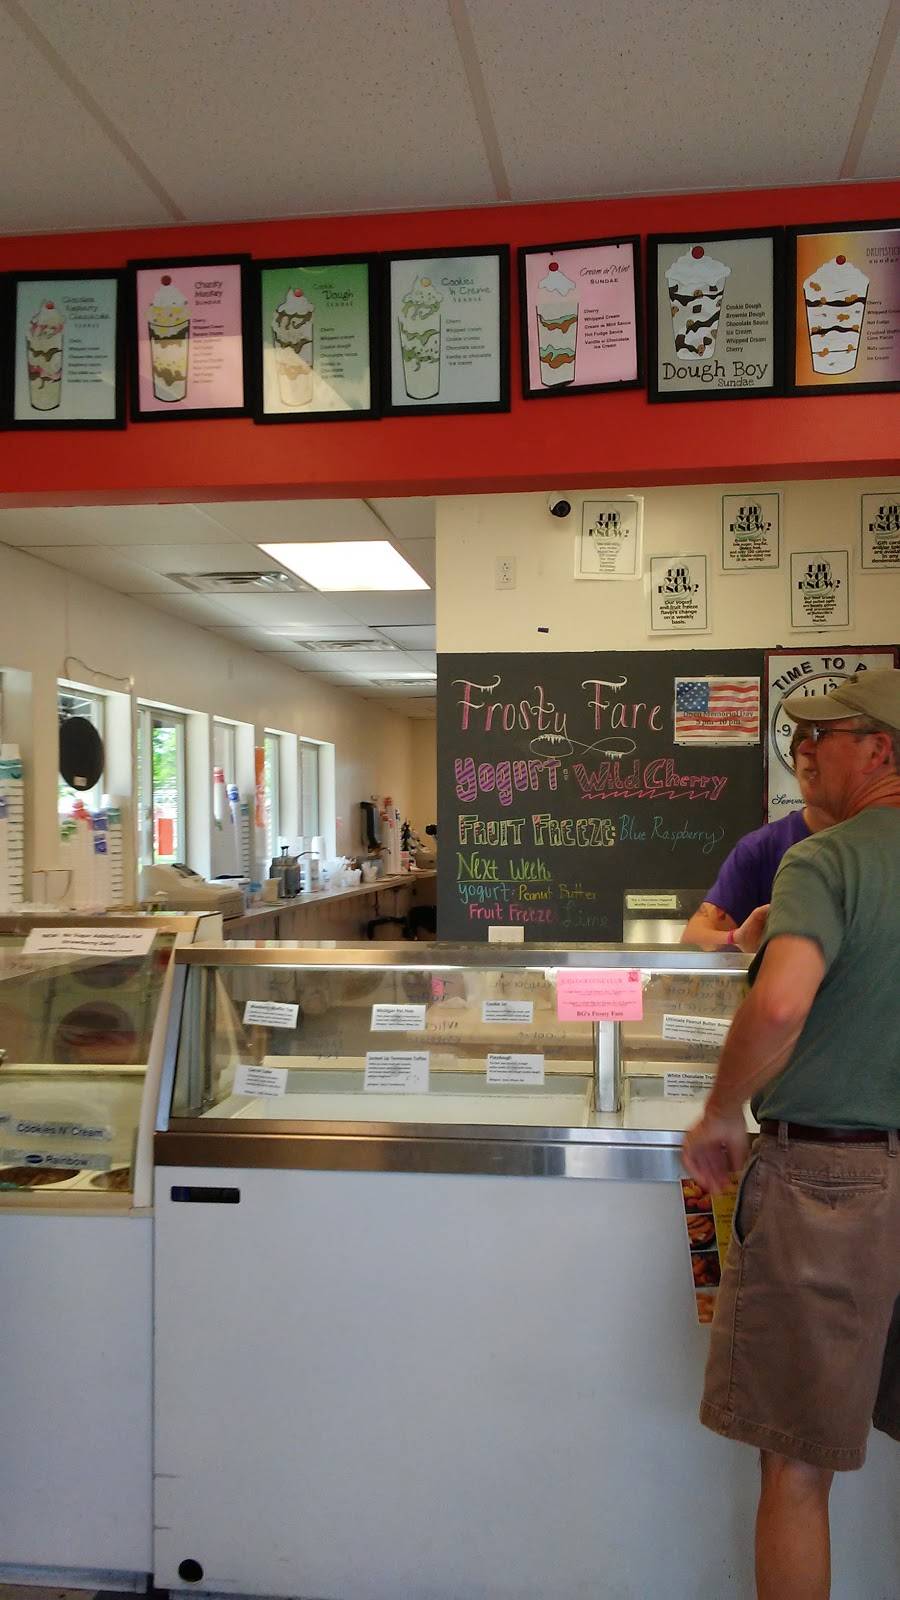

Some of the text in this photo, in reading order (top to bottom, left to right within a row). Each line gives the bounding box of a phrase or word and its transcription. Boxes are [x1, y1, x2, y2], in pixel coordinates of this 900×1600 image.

[321, 289, 354, 301] Dough
[662, 360, 769, 382] Dough Boy
[717, 377, 755, 388] Sundae
[771, 661, 813, 692] TIME
[821, 657, 845, 670] TO
[451, 675, 664, 738] Frosty Fare
[781, 724, 792, 740] 9
[572, 759, 641, 792] Wild
[642, 757, 728, 801] Cherry
[458, 814, 526, 847] FRUIT
[619, 814, 646, 842] Blue
[650, 816, 725, 854] Raspberry
[456, 852, 498, 880] Next
[519, 884, 552, 901] Peanut
[559, 883, 598, 901] Butter
[468, 903, 503, 922] Fruit
[16, 1122, 56, 1135] Cookies
[71, 1126, 104, 1138] Cream
[45, 1155, 89, 1167] Rainbow
